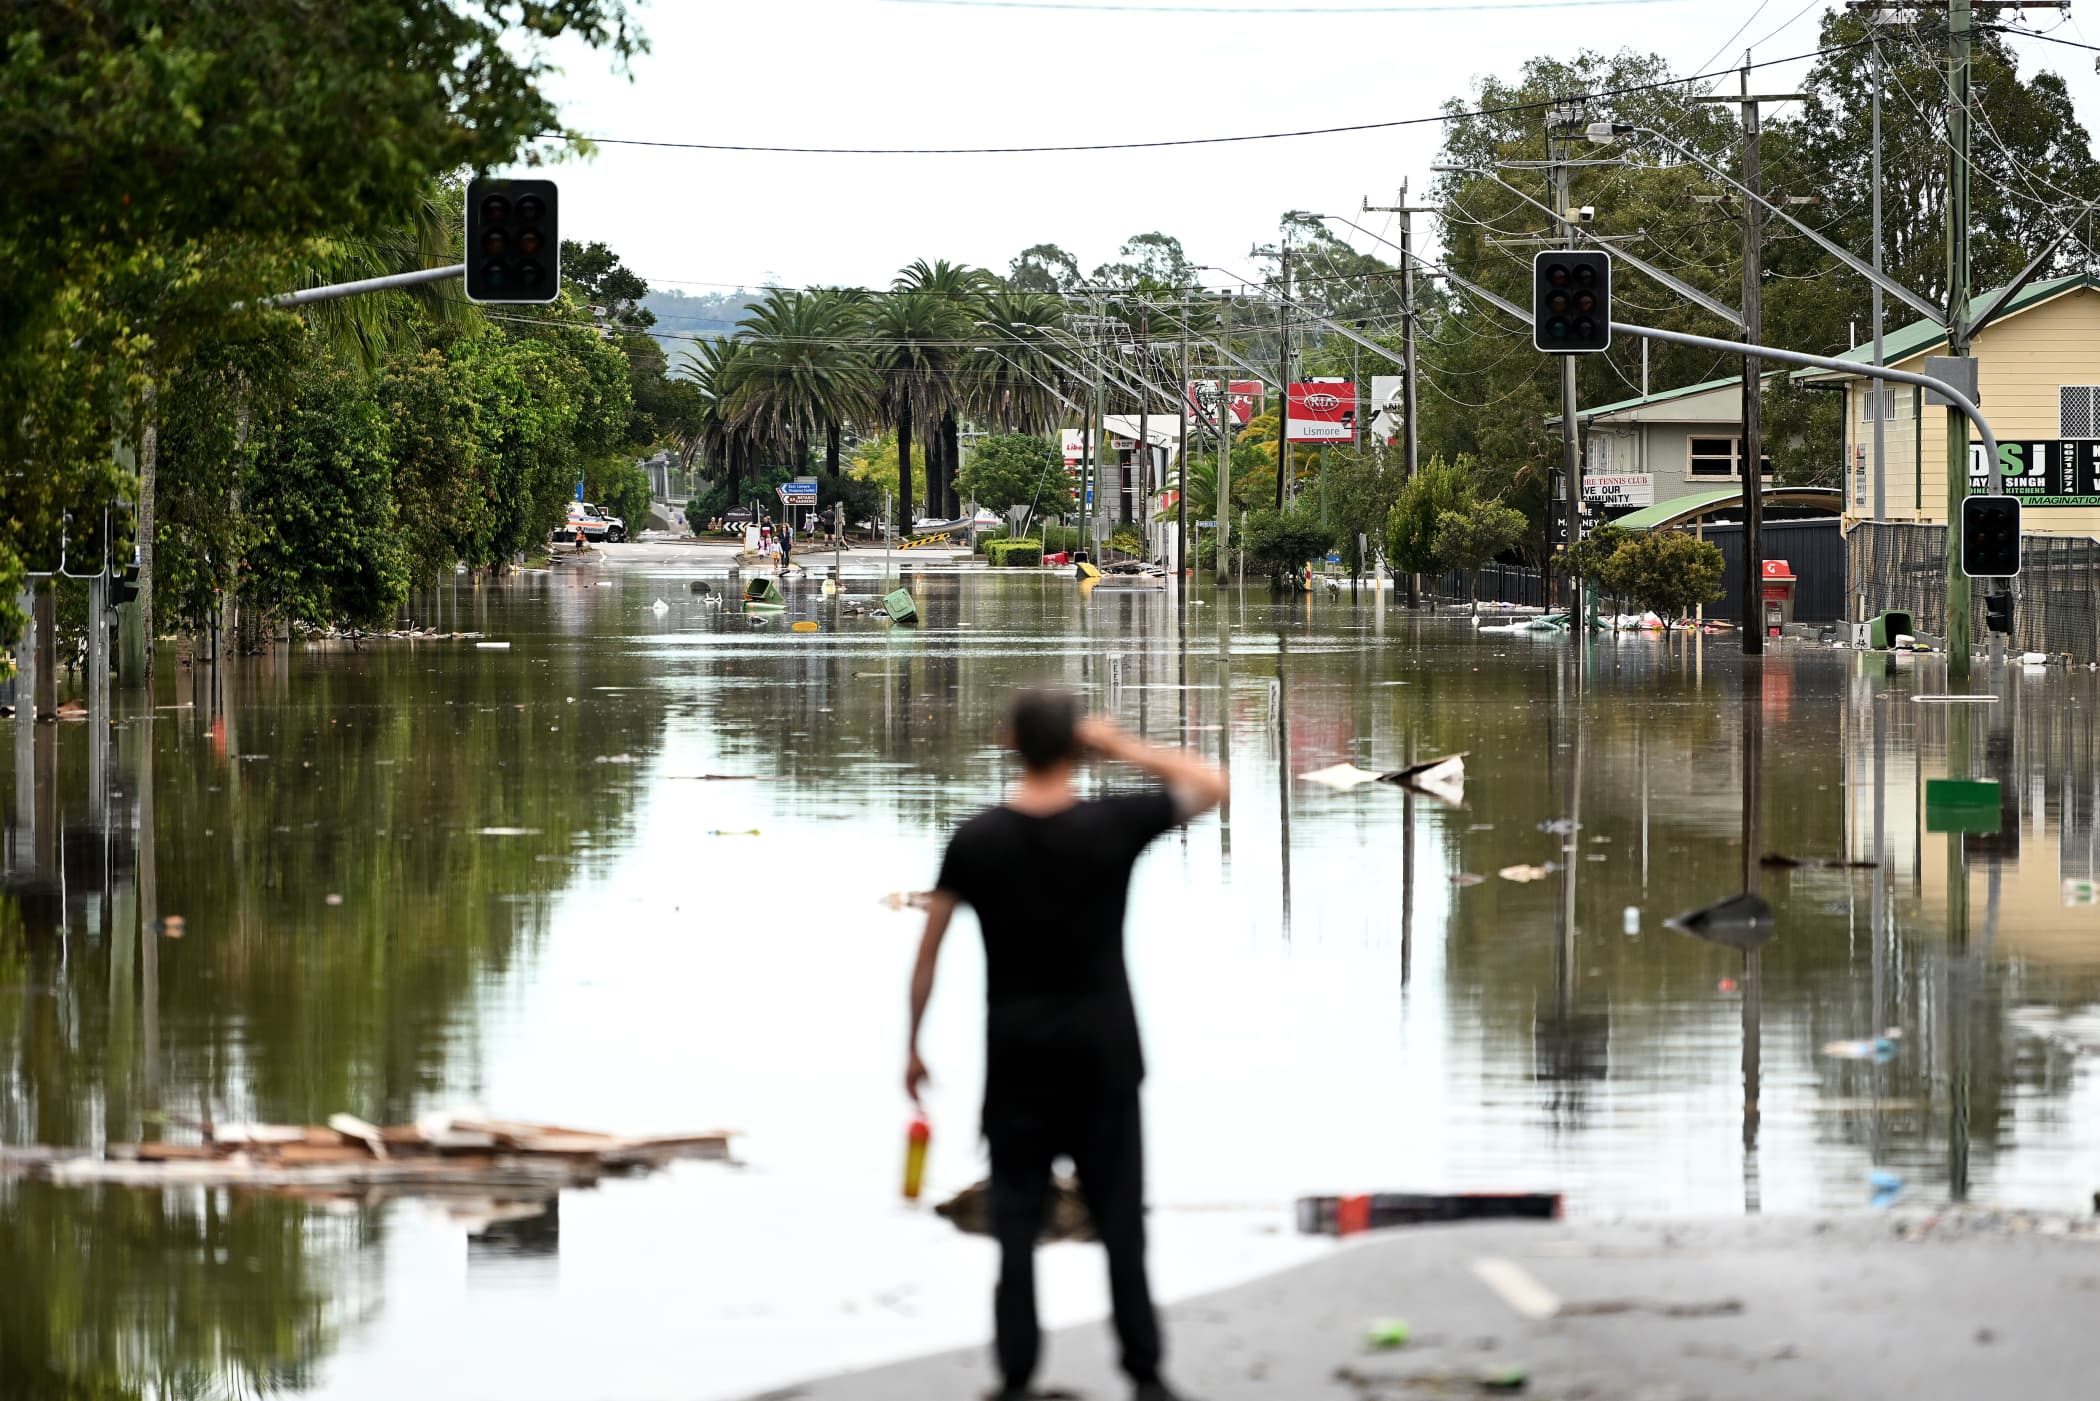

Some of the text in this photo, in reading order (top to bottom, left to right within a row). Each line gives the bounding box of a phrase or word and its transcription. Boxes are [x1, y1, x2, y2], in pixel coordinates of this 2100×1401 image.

[1303, 426, 1340, 436] Lismore
[2005, 477, 2046, 487] SINGH
[1602, 485, 1621, 494] OUR
